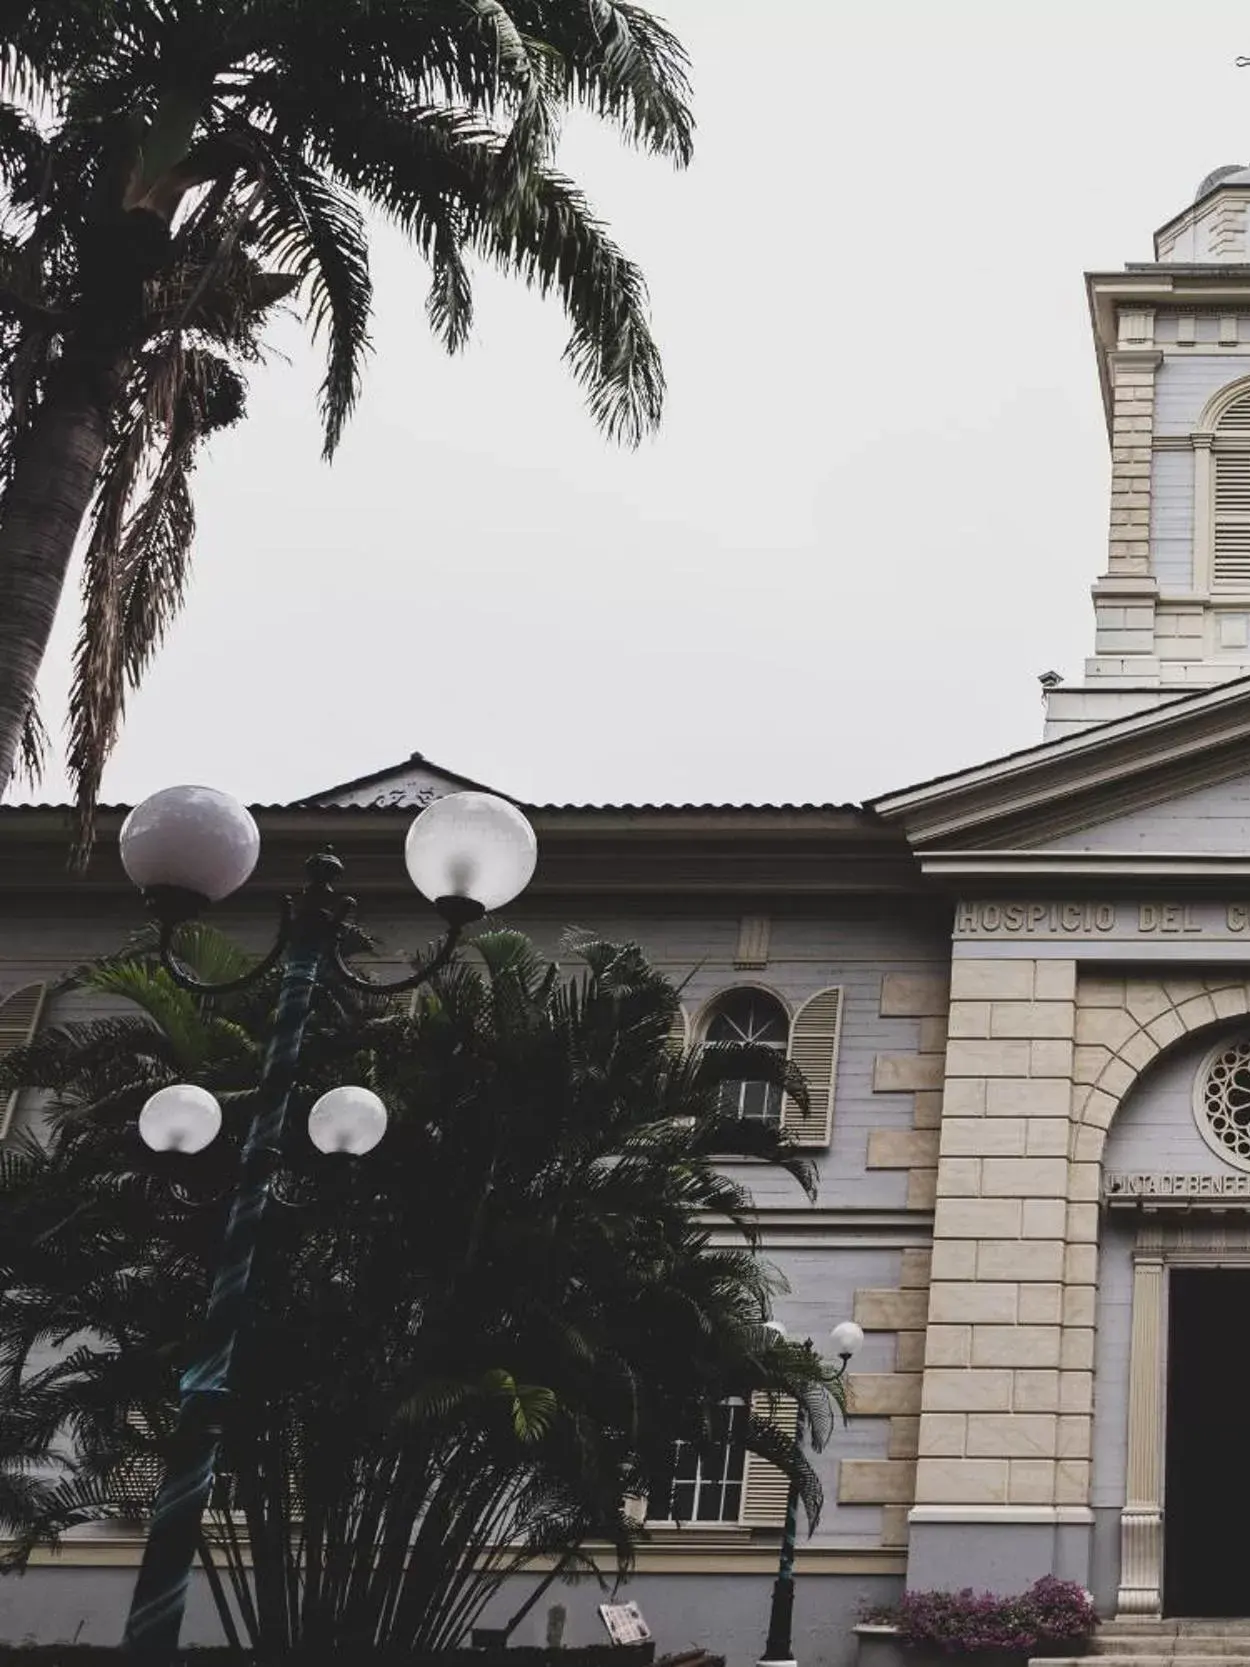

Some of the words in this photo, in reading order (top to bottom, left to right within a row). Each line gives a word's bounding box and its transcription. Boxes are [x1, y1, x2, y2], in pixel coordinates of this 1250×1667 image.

[957, 902, 1116, 932] HOSPICIO
[1138, 902, 1202, 932] DEL
[1160, 1175, 1184, 1193] DE
